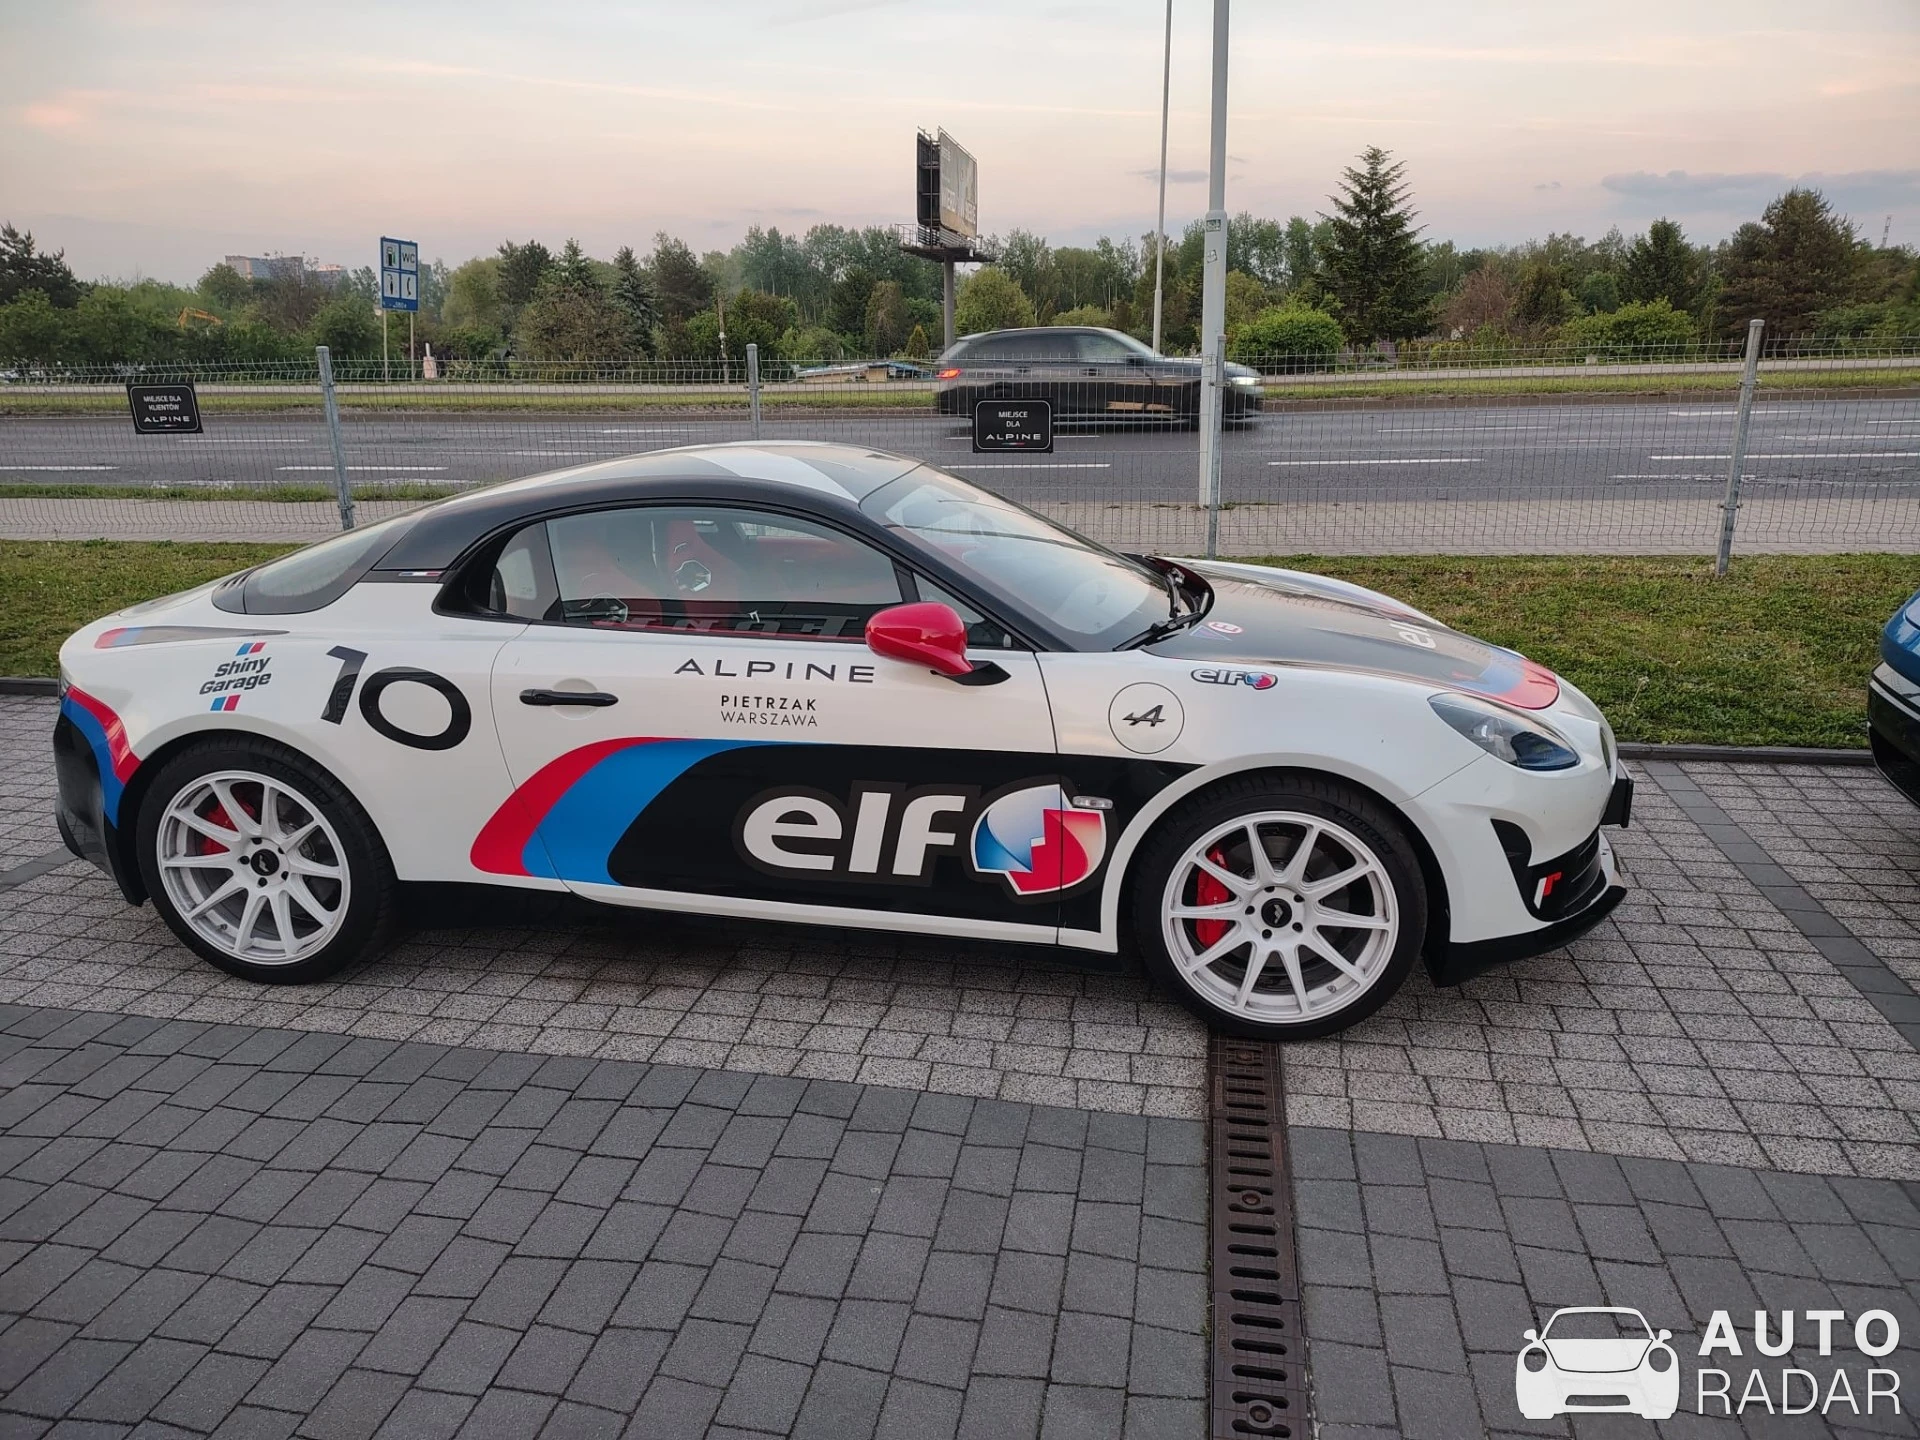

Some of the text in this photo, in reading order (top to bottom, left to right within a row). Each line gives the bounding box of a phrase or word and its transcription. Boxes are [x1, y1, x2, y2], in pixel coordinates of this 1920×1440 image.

[402, 253, 415, 264] WC
[143, 395, 168, 403] MIEJSCE
[148, 403, 180, 411] KLIENTÓW
[1006, 420, 1020, 428] DLA
[986, 433, 1041, 441] ALPINE
[214, 656, 271, 678] Shiny
[673, 658, 875, 683] ALPINE
[199, 672, 272, 695] Garage
[1192, 669, 1245, 685] elf
[320, 645, 472, 751] 10
[721, 695, 816, 711] PIETRZAK
[720, 711, 818, 727] WARSZAWA
[743, 791, 966, 877] elf
